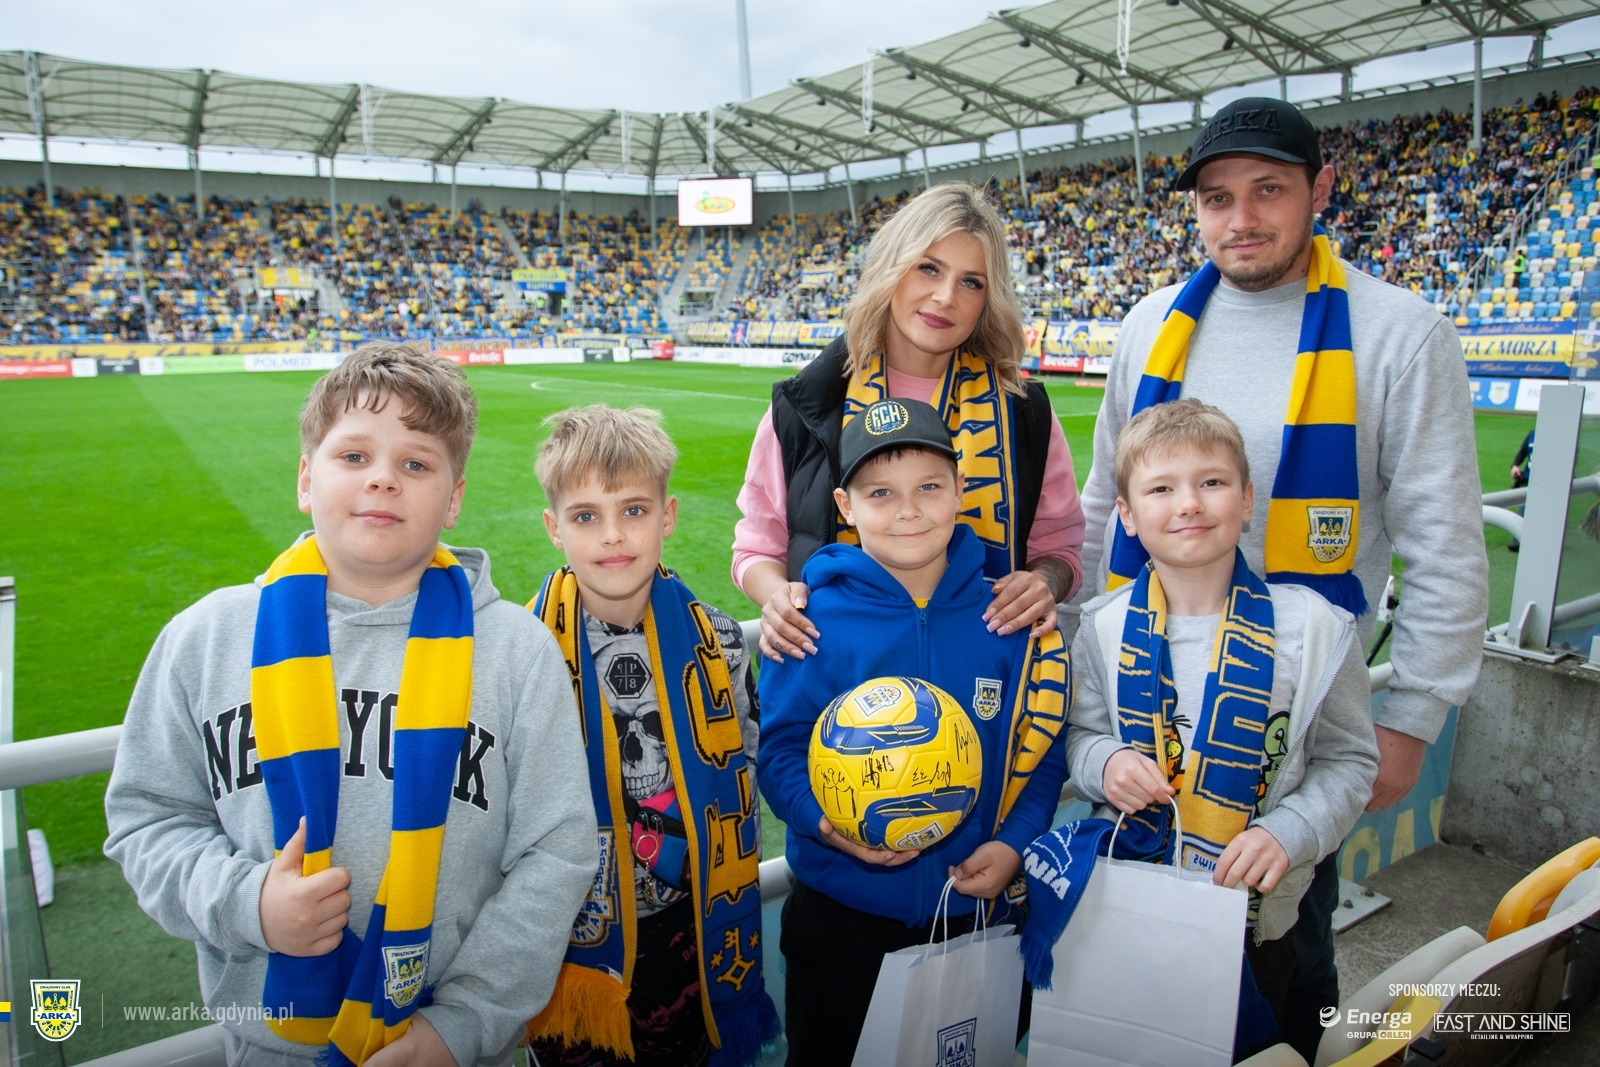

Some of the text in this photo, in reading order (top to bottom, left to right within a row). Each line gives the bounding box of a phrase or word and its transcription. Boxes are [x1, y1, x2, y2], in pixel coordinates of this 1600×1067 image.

[1198, 108, 1282, 153] ARKA
[1499, 341, 1557, 356] MORZA
[203, 703, 264, 800] NE
[396, 975, 422, 990] ARKA
